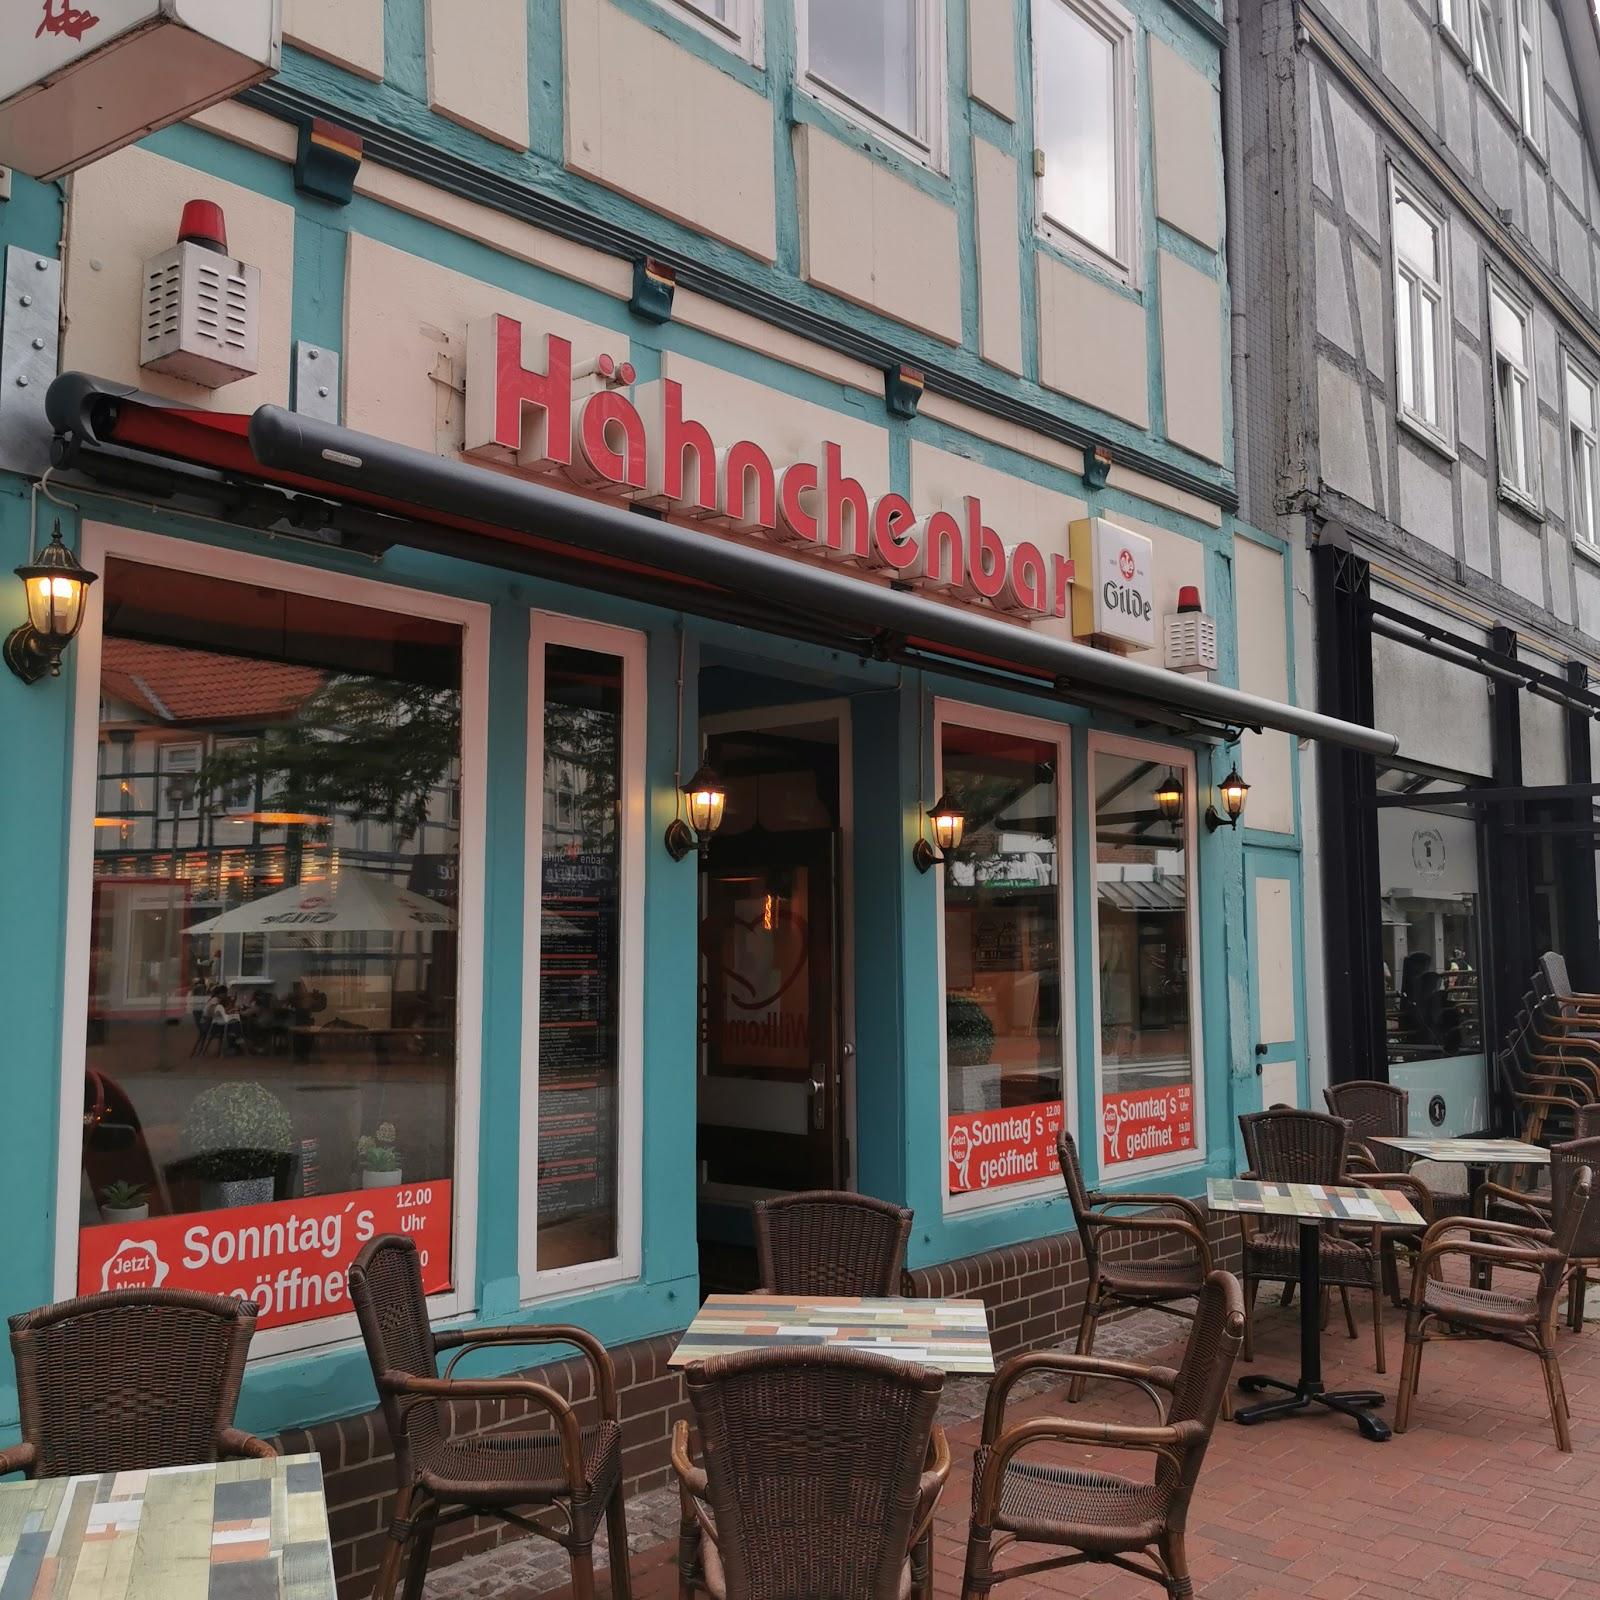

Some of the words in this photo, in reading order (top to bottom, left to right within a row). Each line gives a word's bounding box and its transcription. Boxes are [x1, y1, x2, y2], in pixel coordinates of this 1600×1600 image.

[486, 312, 1076, 619] Hähnchenbar
[1103, 580, 1152, 622] Gilde
[1046, 1105, 1061, 1117] 12.00
[1048, 1121, 1059, 1132] Uhr
[1046, 1145, 1058, 1157] 19.0
[1126, 1124, 1173, 1158] geöffnet
[980, 1147, 1039, 1188] geöffnet
[395, 1187, 433, 1209] 12.00
[400, 1214, 427, 1233] Uhr
[113, 1254, 151, 1275] Jetzt
[215, 1262, 354, 1318] öffne
